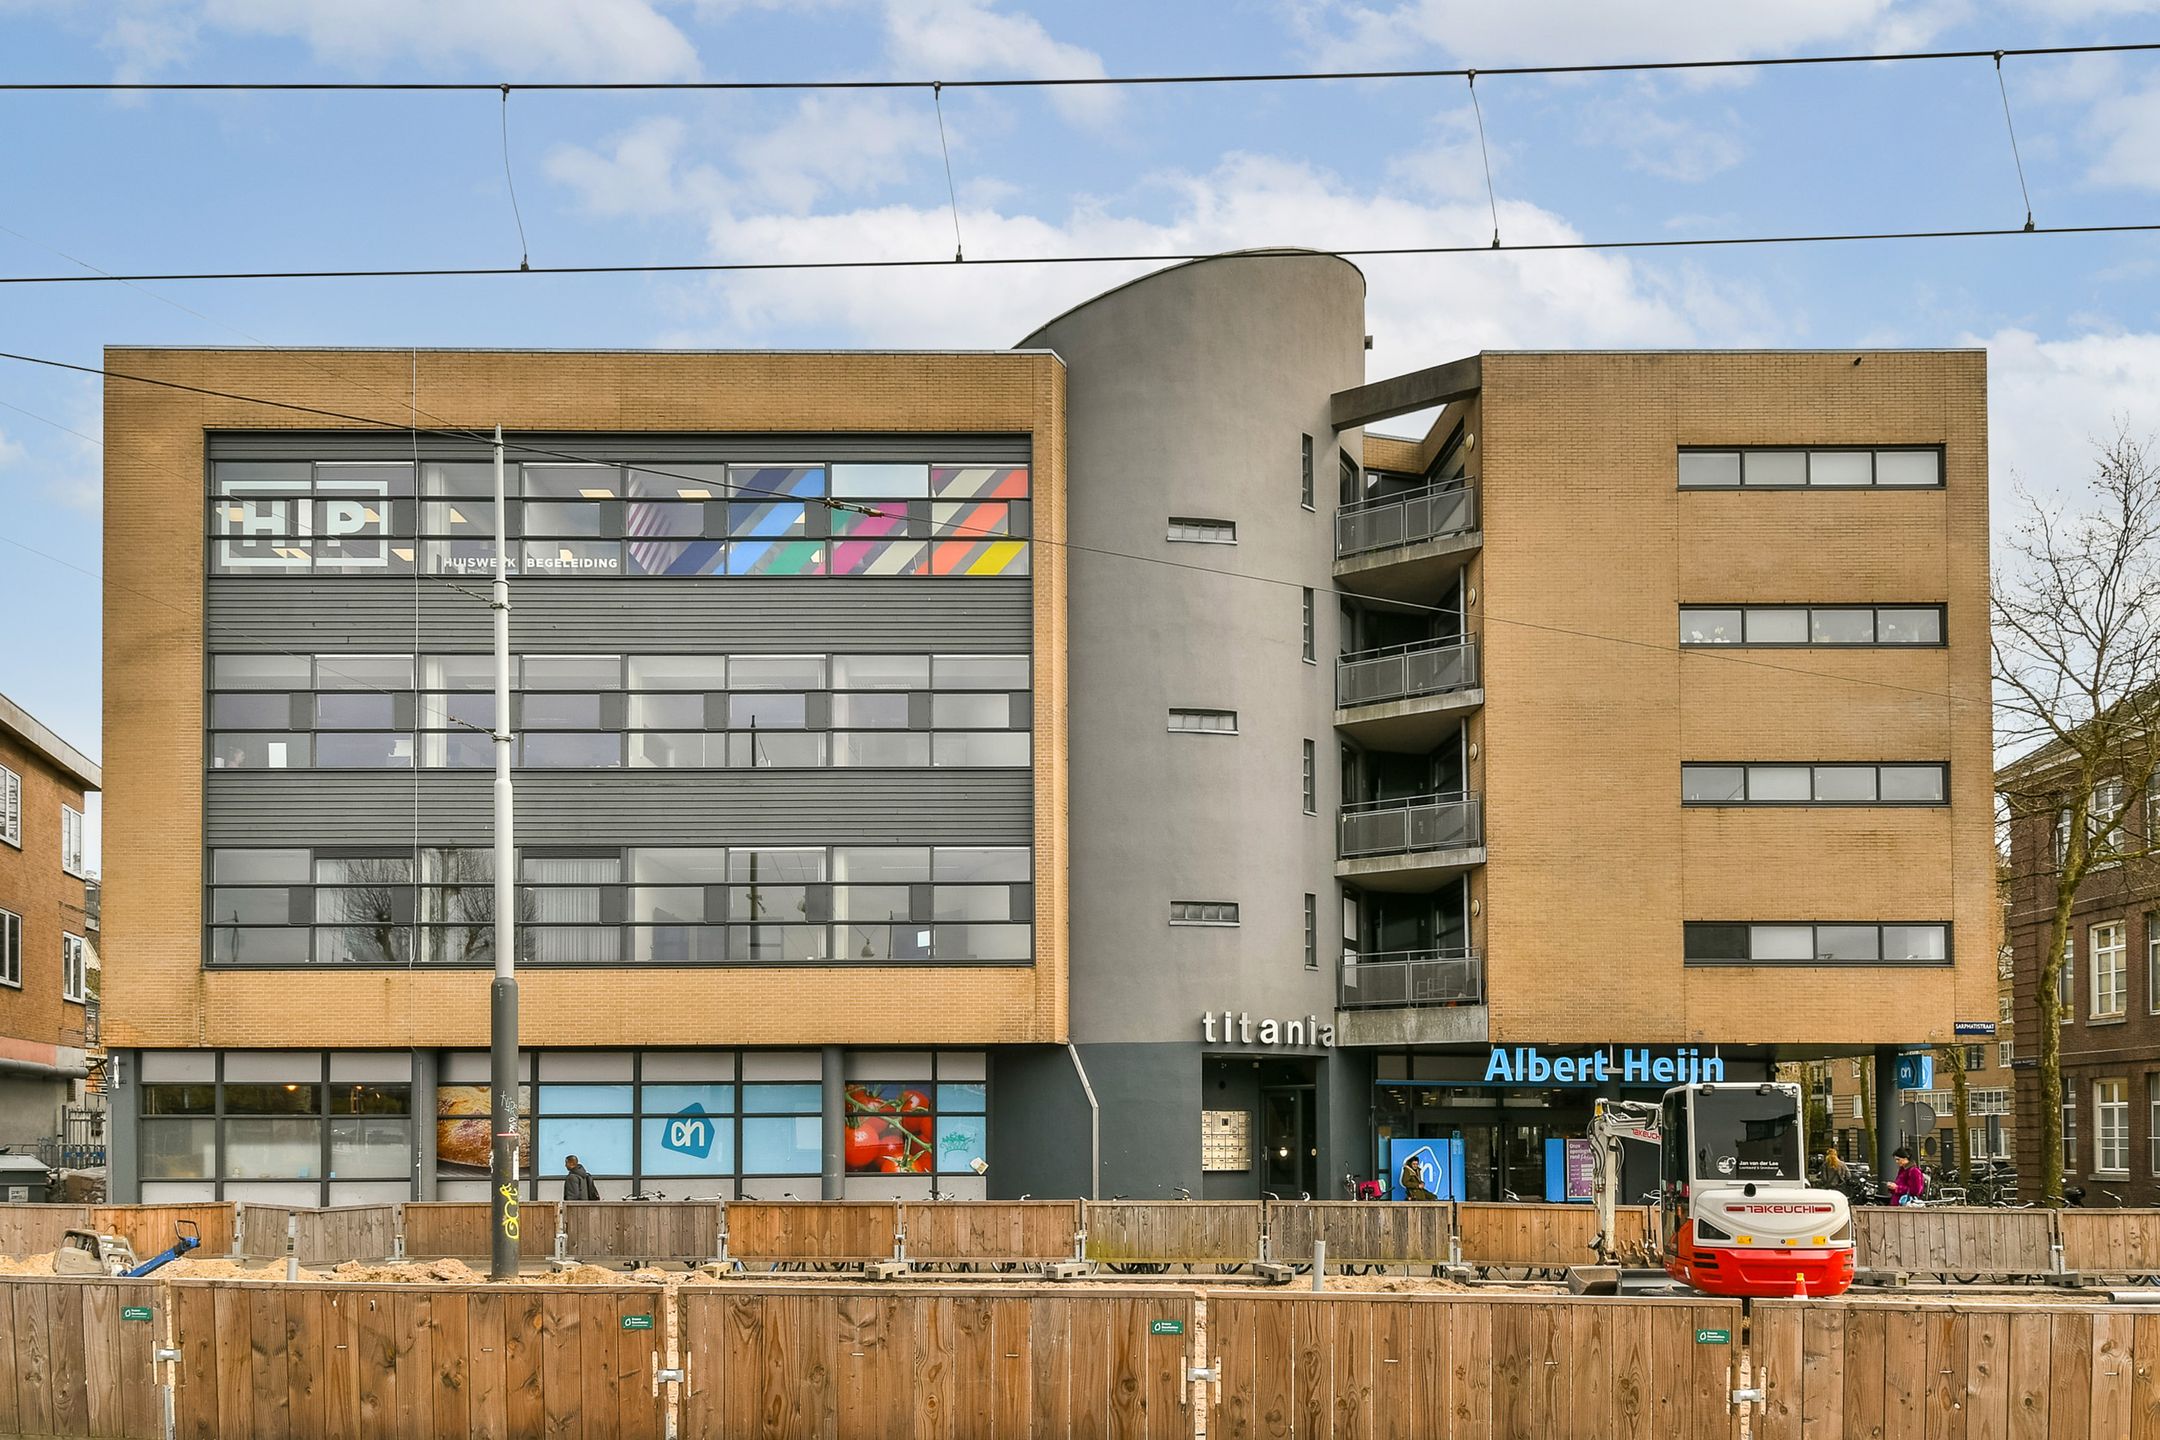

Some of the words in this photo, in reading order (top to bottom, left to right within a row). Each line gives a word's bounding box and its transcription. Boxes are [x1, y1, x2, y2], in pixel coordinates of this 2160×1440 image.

[242, 499, 366, 547] HIP
[527, 558, 618, 568] BEGELEIDING
[1202, 1011, 1336, 1047] titania
[1484, 1047, 1609, 1082] Albert
[1623, 1047, 1724, 1085] Heijn
[1631, 1127, 1662, 1141] TAKEUCH
[1746, 1205, 1815, 1214] TAKEUCHI
